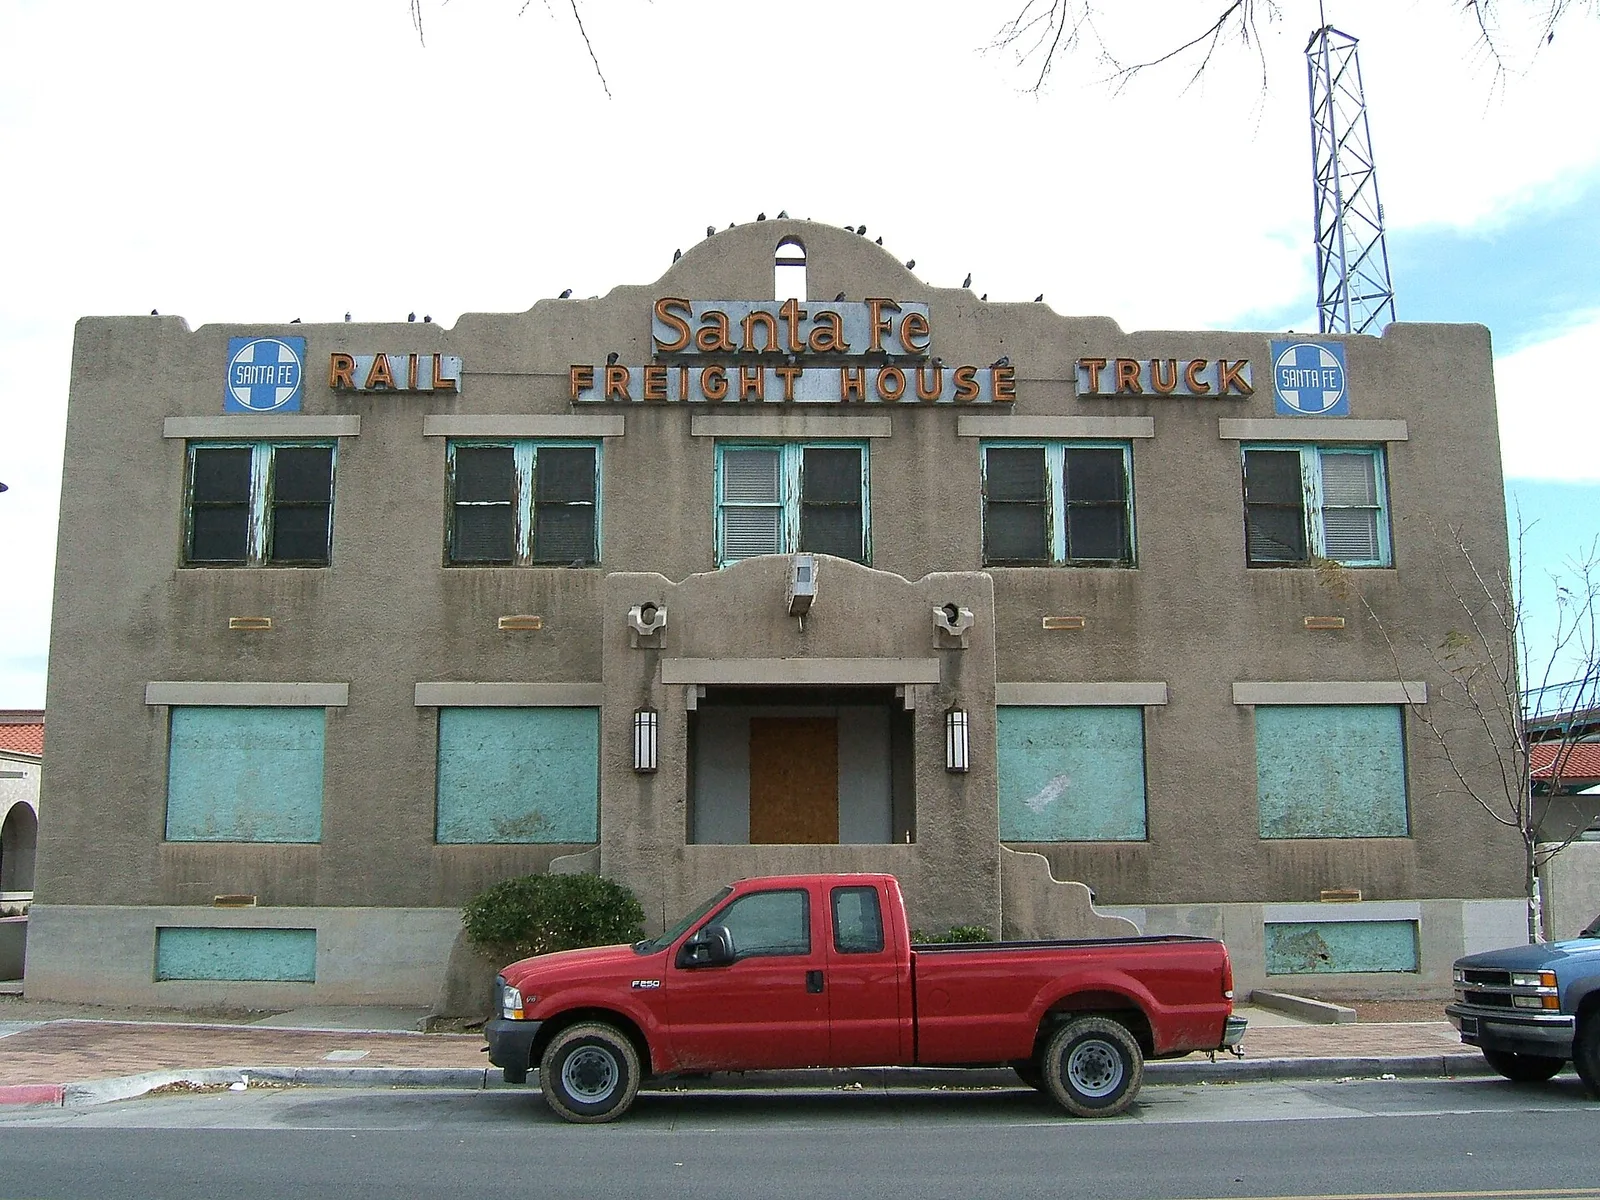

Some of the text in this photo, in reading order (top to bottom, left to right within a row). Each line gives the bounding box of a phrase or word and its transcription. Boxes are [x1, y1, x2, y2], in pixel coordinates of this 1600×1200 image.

[653, 296, 930, 354] Santa Fe
[235, 365, 293, 385] SANTA FE
[329, 352, 457, 390] RAIL
[569, 364, 1017, 401] FREIGHT HOUSE
[1079, 357, 1254, 395] TRUCK
[1281, 368, 1337, 388] SANTA FE
